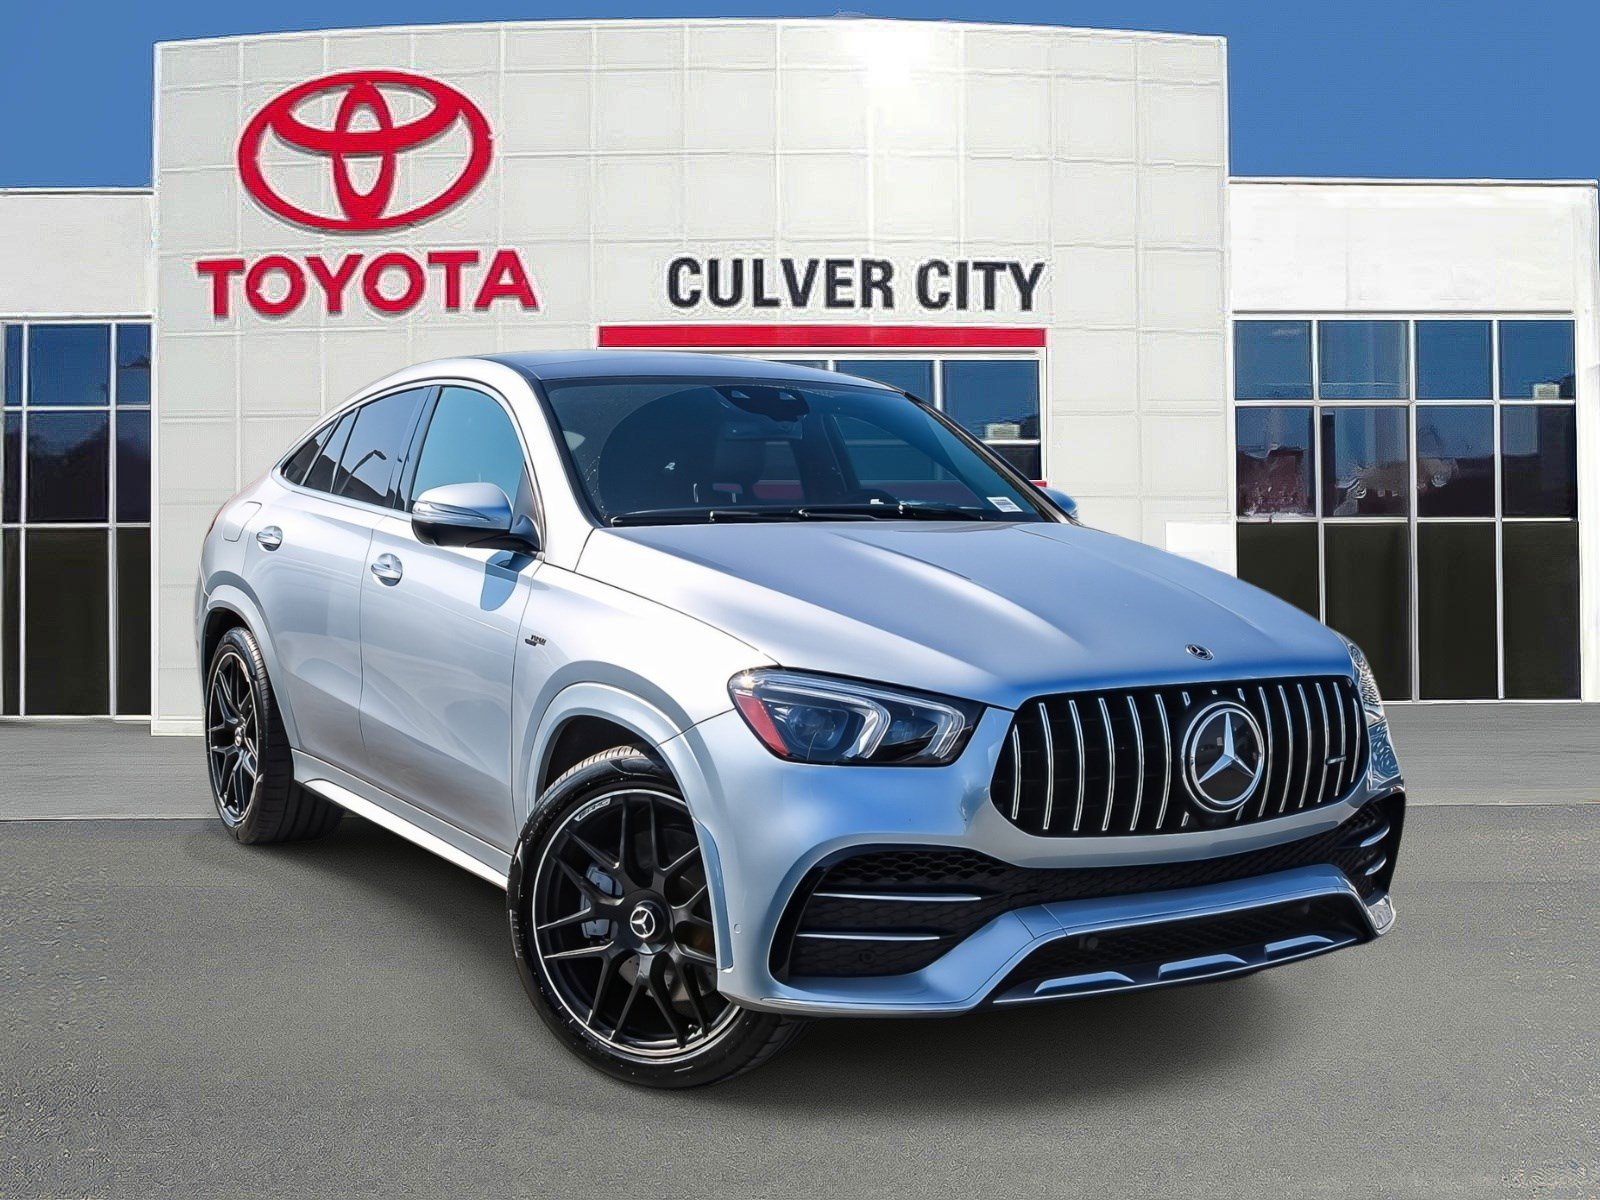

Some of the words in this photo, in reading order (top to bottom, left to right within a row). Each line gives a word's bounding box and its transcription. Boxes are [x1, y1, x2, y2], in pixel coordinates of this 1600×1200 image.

[196, 249, 538, 316] TOYOTA
[668, 257, 894, 308] CULVER
[916, 260, 1045, 311] CITY
